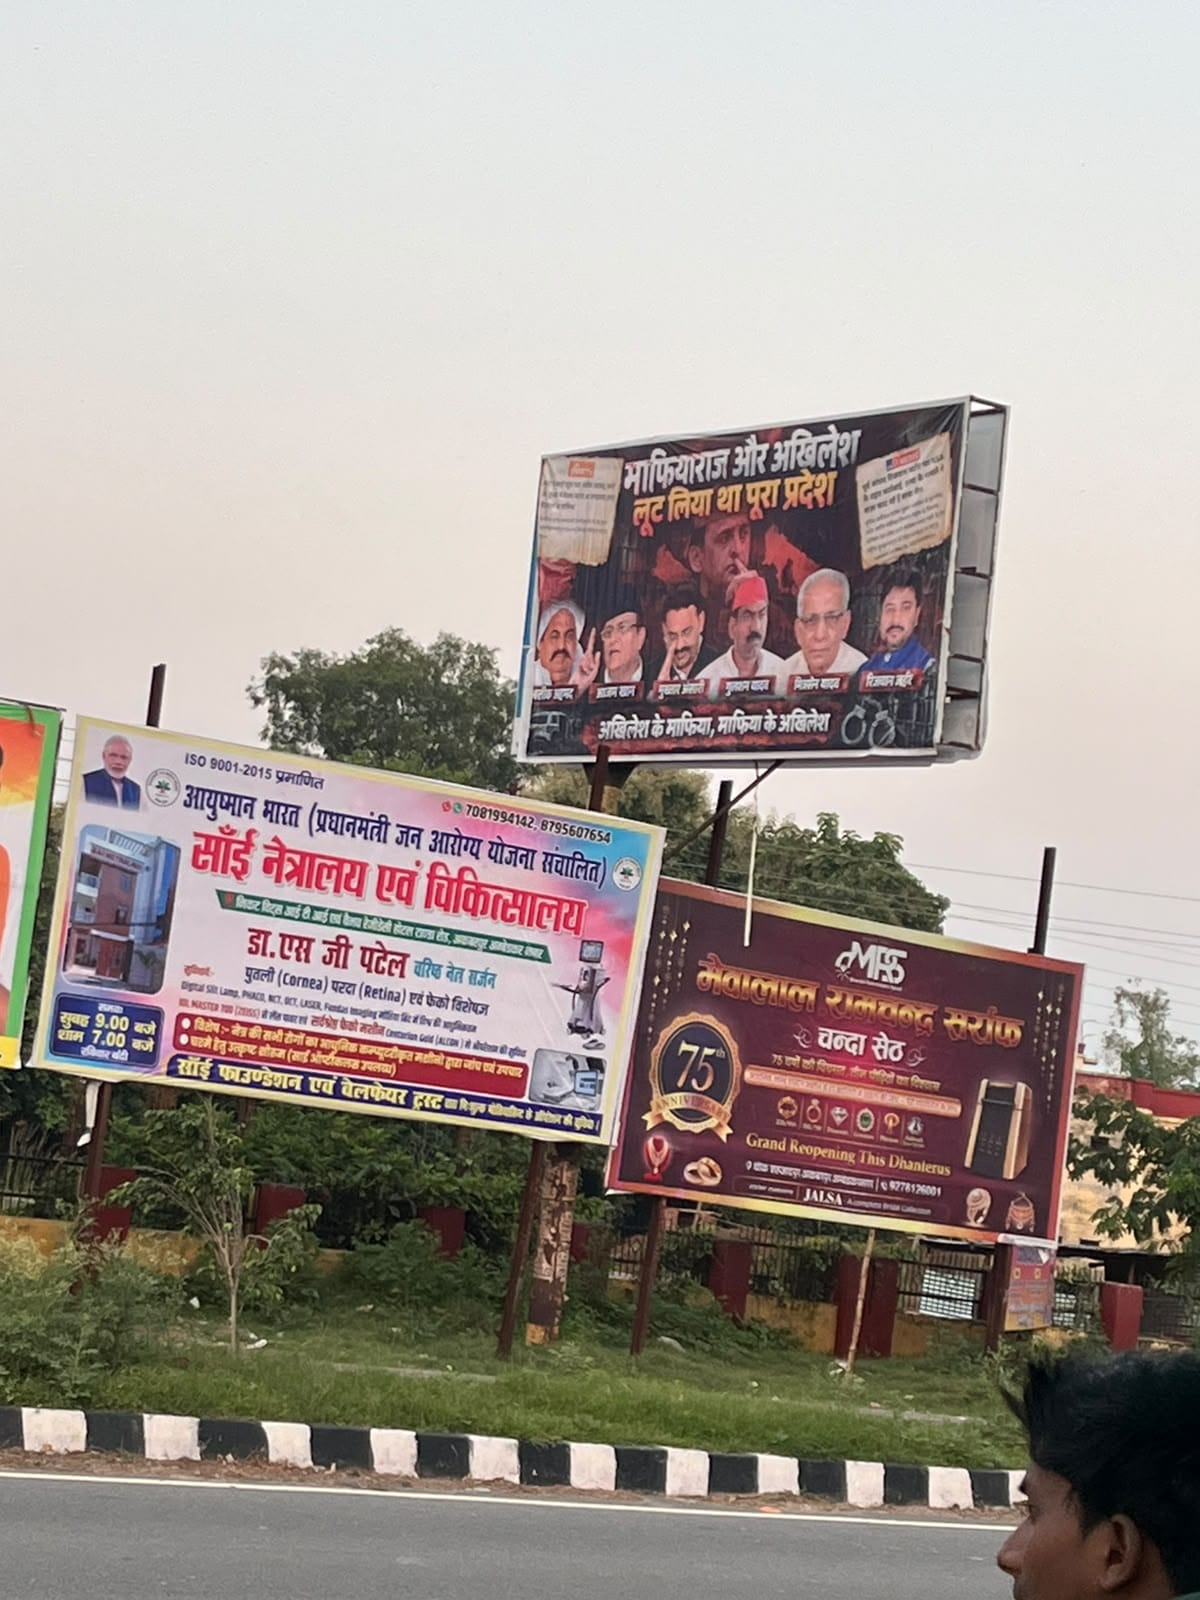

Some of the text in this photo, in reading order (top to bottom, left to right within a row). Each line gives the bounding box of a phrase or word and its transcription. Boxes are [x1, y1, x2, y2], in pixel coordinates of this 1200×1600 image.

[623, 447, 731, 495] माफियाराज
[732, 434, 769, 478] और
[771, 424, 862, 472] अखिलेश
[632, 494, 666, 537] लूट
[667, 486, 714, 522] लिया
[717, 483, 744, 513] था
[746, 478, 781, 520] पूरा
[782, 469, 838, 511] प्रदेश
[598, 708, 831, 740] अखिलेश के माफिया, माफिया के अखिलेश
[184, 753, 325, 790] ISO 9001-2015 प्रमाणित
[183, 784, 257, 821] आयुष्मान
[395, 822, 424, 850] जन
[428, 828, 483, 860] आरोग्य
[487, 836, 536, 870] योजना
[541, 820, 612, 844] 8795607654
[262, 835, 370, 898] नेत्रालय
[376, 859, 419, 907] एवं
[424, 861, 588, 936] चिकित्सालय
[322, 934, 353, 969] जी
[360, 941, 410, 978] पटेल
[414, 957, 443, 981] वरिष्ठ
[468, 967, 498, 989] सर्जन
[245, 966, 275, 984] पुतली
[278, 969, 328, 993] (Cornea)
[331, 980, 357, 997] परदा
[359, 982, 406, 1006] (Retina)
[409, 990, 424, 1006] एवं
[426, 991, 450, 1012] फेको
[696, 952, 820, 1013] मेवालाल
[825, 984, 938, 1038] रामचन्द्र
[57, 1029, 155, 1052] शाम 7.00 बजे
[95, 1013, 129, 1031] 9.00
[134, 1020, 157, 1035] बजे
[249, 1025, 262, 1039] की
[817, 1027, 906, 1062] चन्दा सेठ
[218, 1063, 303, 1091] फाउण्डेशन
[309, 1074, 338, 1096] एवं
[341, 1075, 409, 1106] वेलफेयर
[413, 1091, 444, 1111] ट्रस्ट
[746, 1132, 786, 1153] Grand
[789, 1138, 856, 1165] Reopening
[858, 1150, 886, 1167] This
[803, 1187, 843, 1206] JALSA
